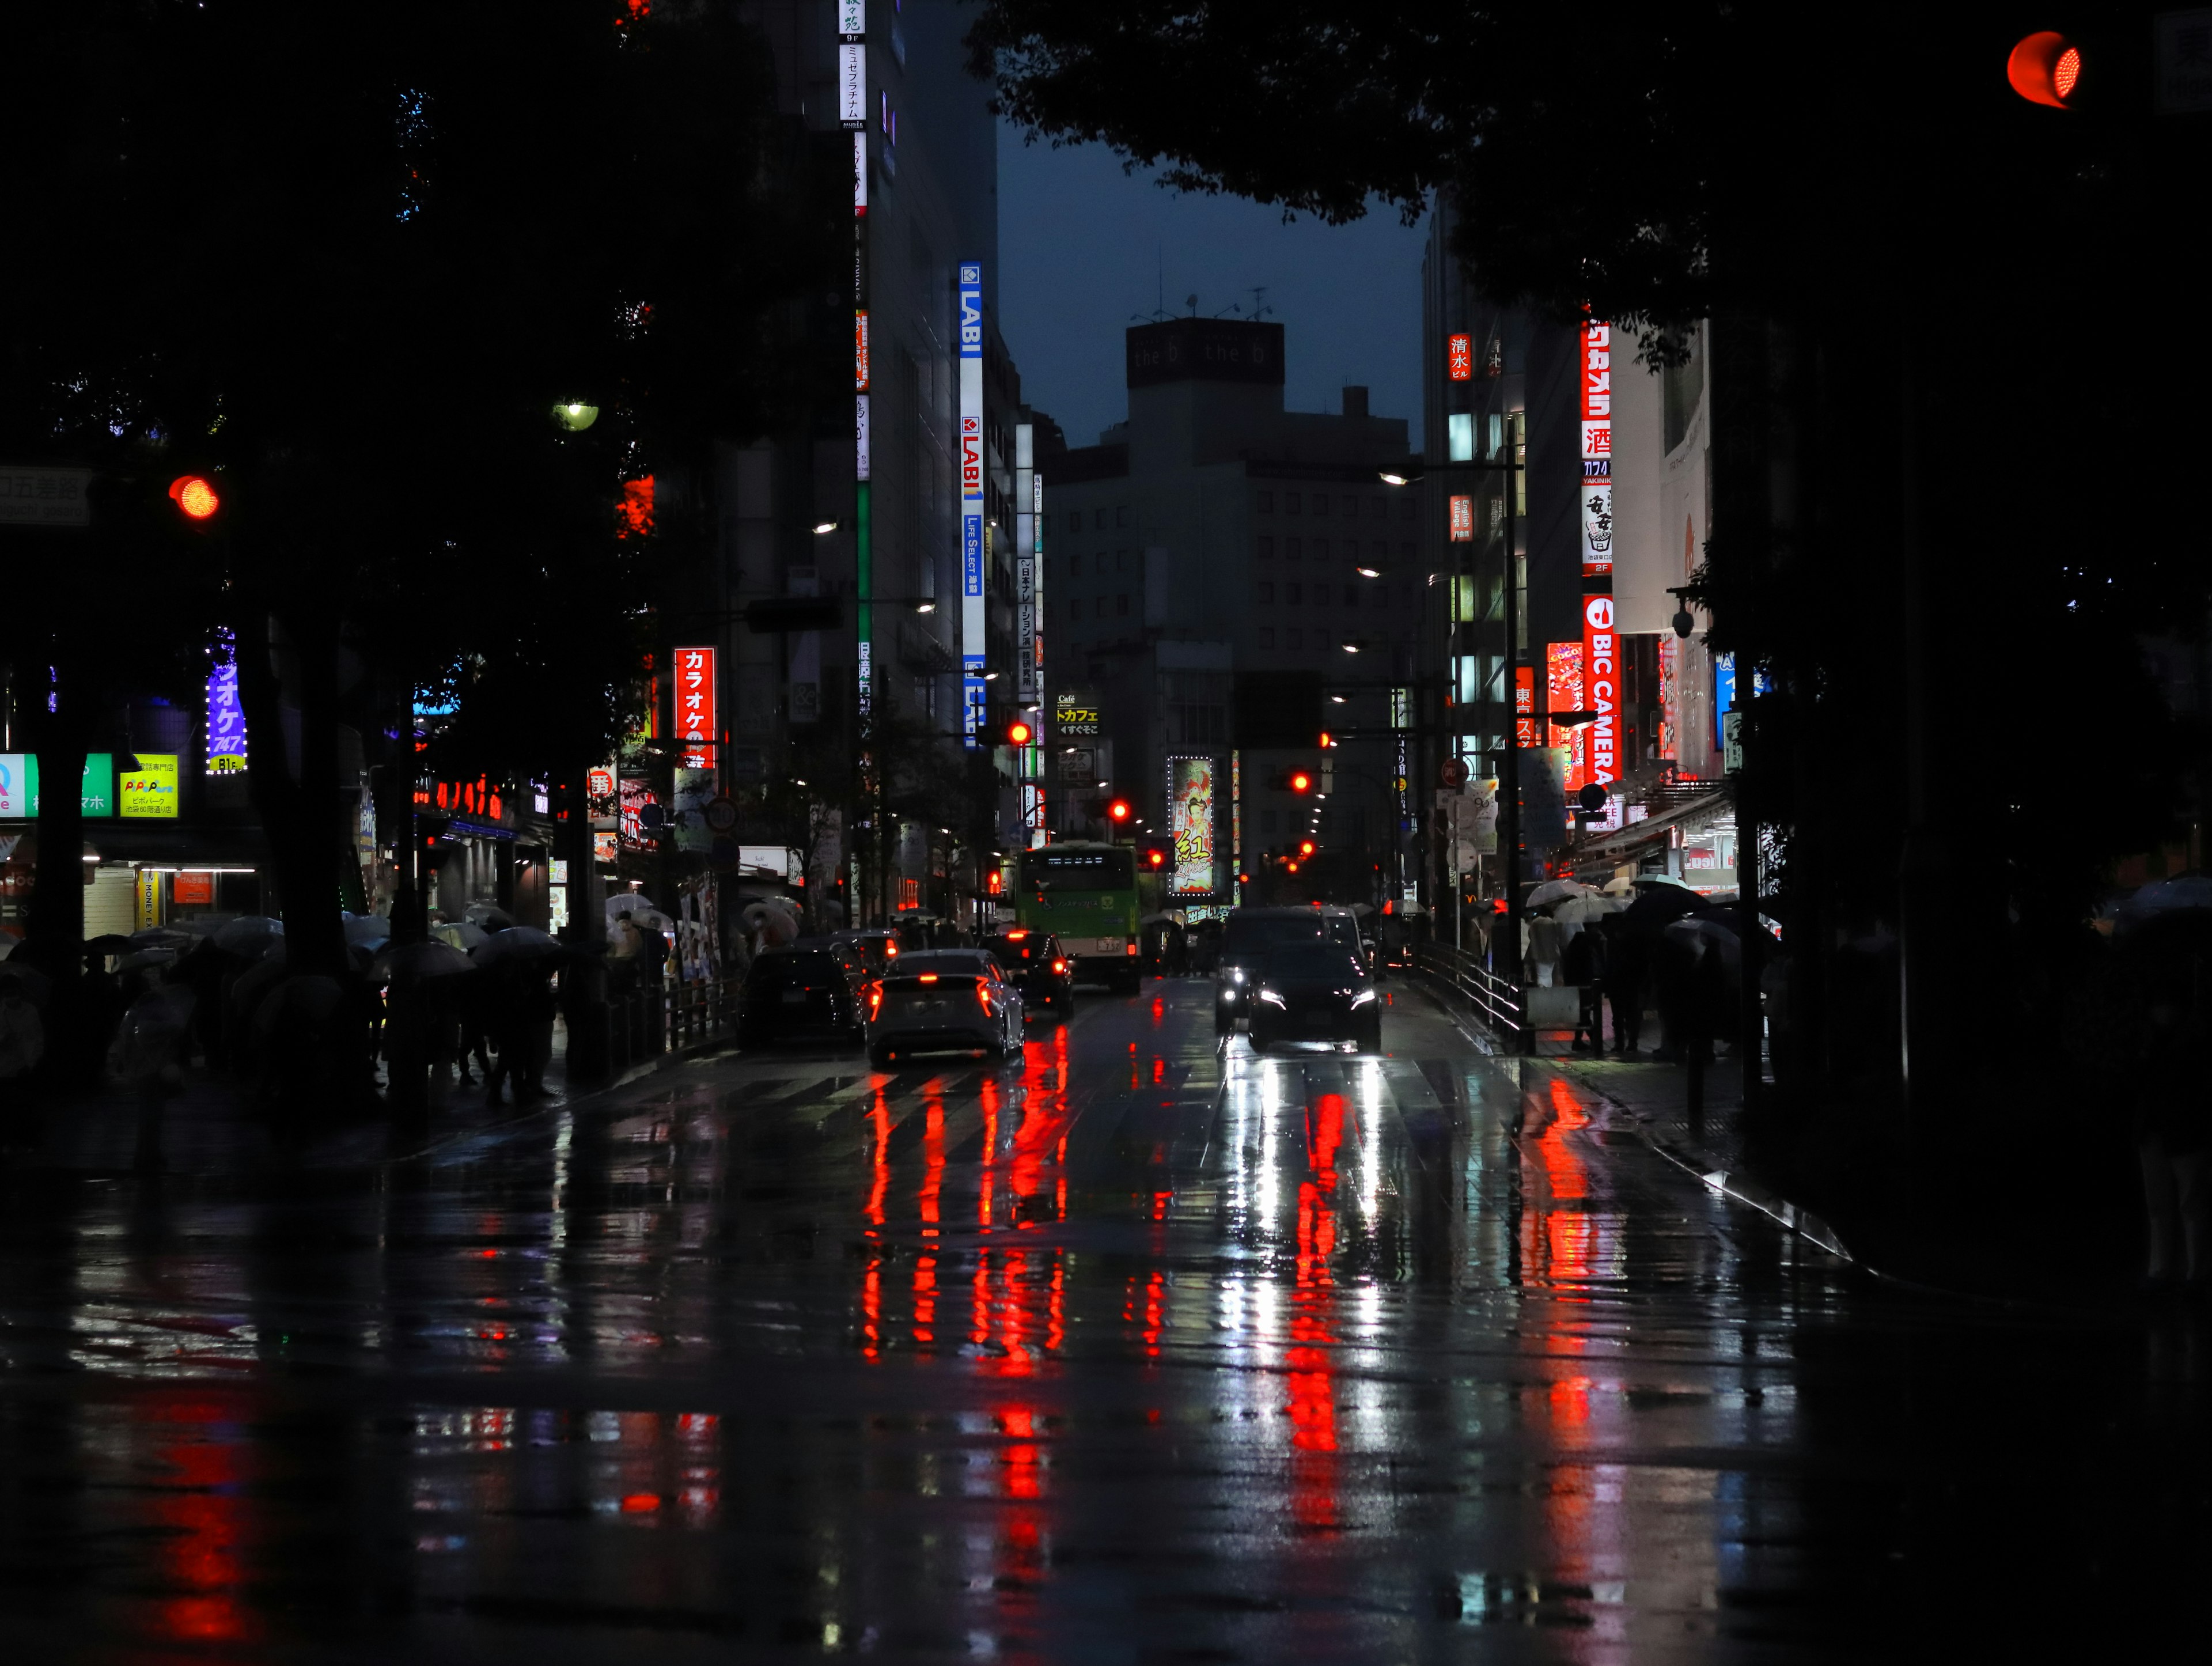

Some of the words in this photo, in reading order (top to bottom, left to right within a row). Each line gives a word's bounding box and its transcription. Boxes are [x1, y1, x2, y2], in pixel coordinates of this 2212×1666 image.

[961, 291, 980, 351] LABI
[1205, 343, 1239, 362] the
[1451, 338, 1468, 368] 清水
[1587, 429, 1611, 453] 酒
[963, 436, 979, 487] LABI
[968, 517, 978, 537] LIFE
[1453, 500, 1461, 527] Village
[1461, 499, 1469, 527] English
[968, 539, 978, 573] SELECT
[1592, 634, 1613, 675] BIC
[685, 652, 704, 729] カラオケ
[213, 735, 241, 752] 747
[1067, 725, 1099, 734] すぐそこ
[1593, 680, 1613, 786] CAMERA
[1176, 828, 1210, 864] 紅
[1058, 900, 1098, 909] ノンステップバス
